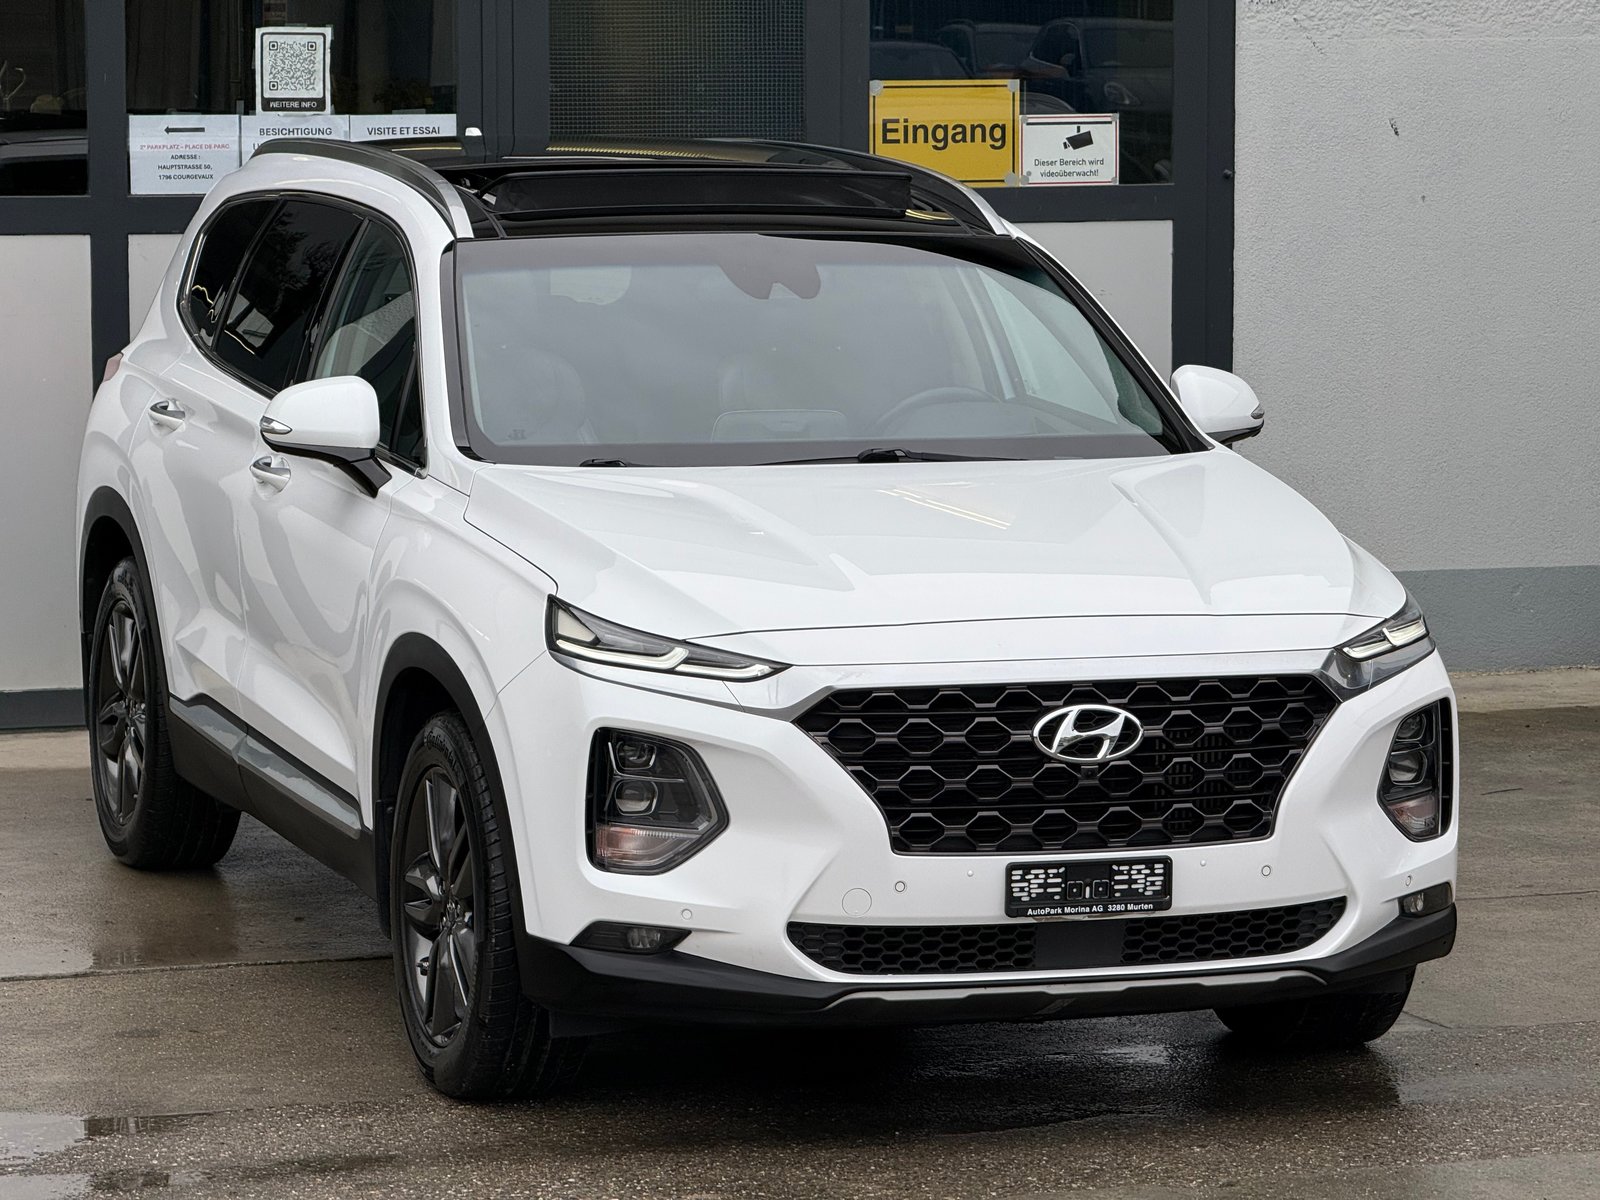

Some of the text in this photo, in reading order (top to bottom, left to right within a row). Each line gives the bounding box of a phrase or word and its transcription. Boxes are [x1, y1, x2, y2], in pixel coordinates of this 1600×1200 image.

[269, 101, 300, 109] WEITERE
[259, 127, 333, 136] BESICHTIGUNG
[366, 126, 440, 136] VISITE ET ESSAI
[881, 118, 1007, 151] Eingang
[1034, 157, 1105, 167] Dieser Bereich wird
[1040, 168, 1099, 177] videoüberwacht!
[1027, 907, 1062, 915] AutoPark
[1064, 905, 1090, 913] Morina
